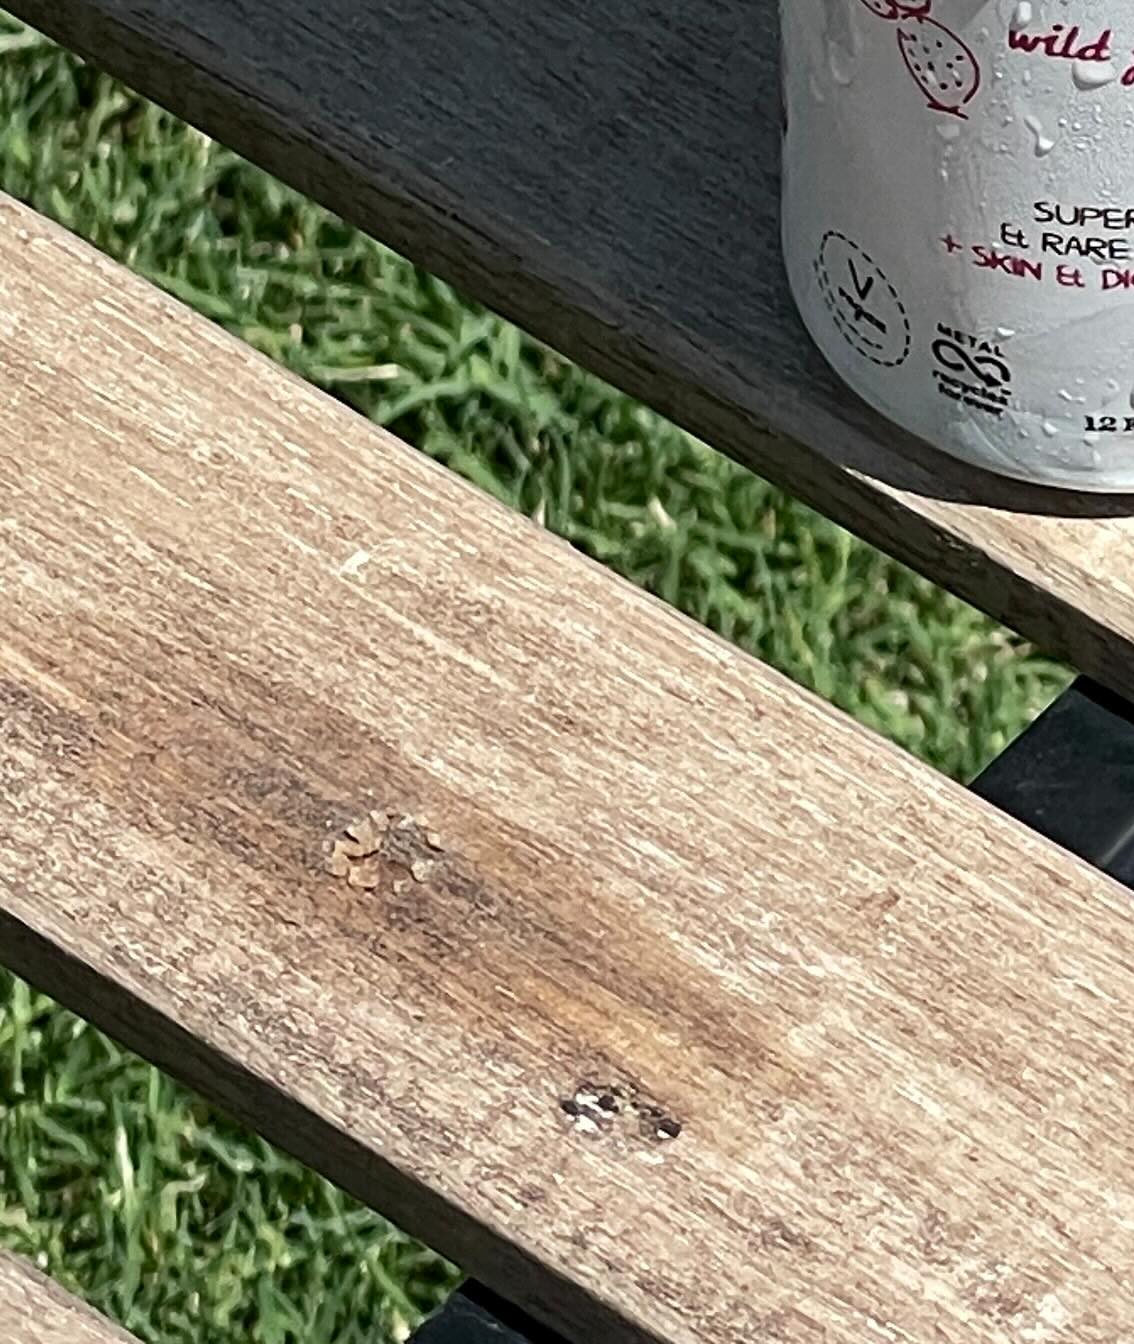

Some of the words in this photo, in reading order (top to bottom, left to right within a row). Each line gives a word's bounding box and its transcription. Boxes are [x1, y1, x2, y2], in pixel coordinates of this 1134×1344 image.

[1007, 23, 1112, 62] wild
[1041, 231, 1130, 261] RARE
[970, 245, 1043, 281] SKIN
[1083, 414, 1118, 432] 12
